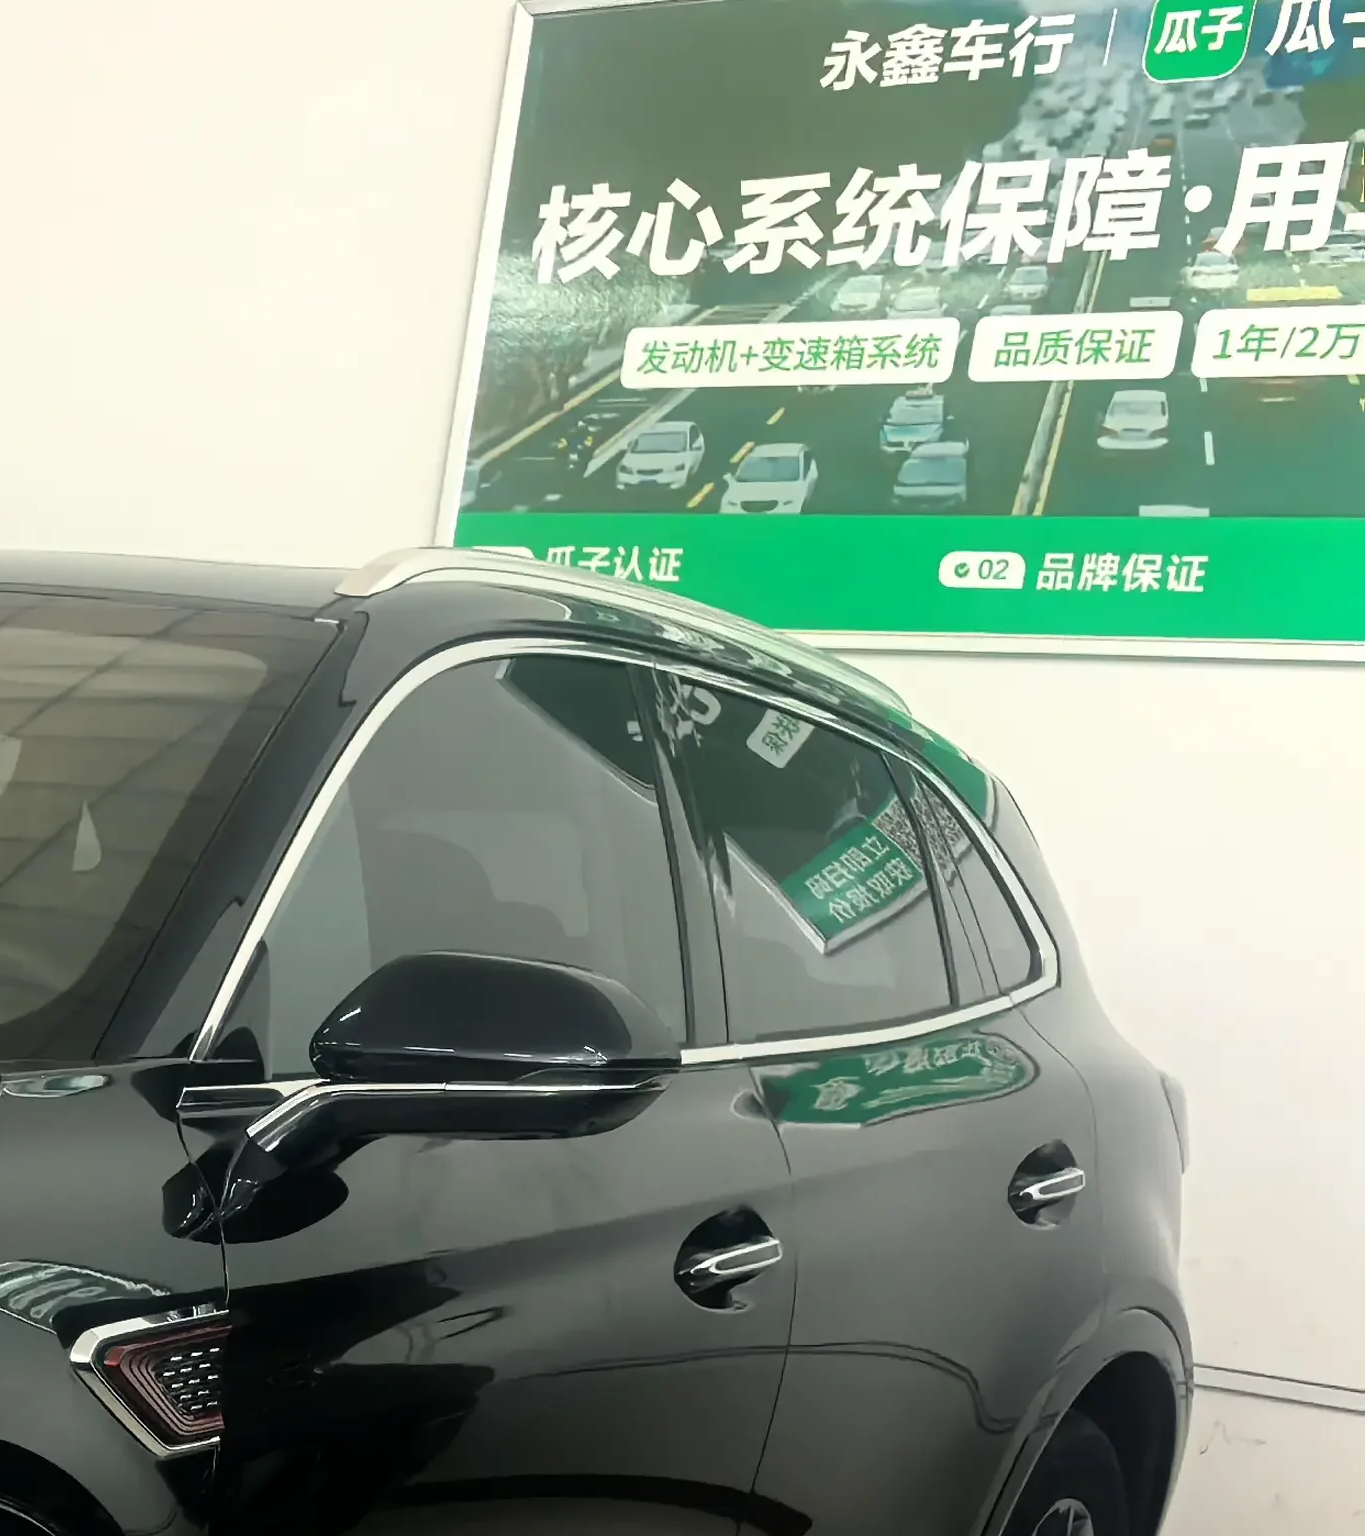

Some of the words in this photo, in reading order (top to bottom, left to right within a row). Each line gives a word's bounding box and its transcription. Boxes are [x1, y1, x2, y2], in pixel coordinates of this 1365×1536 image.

[819, 14, 1075, 91] 永鑫车行
[1154, 5, 1244, 56] 瓜子
[1265, 0, 1365, 55] 瓜
[531, 141, 1365, 284] 核心系统保障·用
[636, 332, 943, 375] 发动机+变速箱系统
[993, 328, 1157, 369] 品质保证
[976, 559, 1008, 582] 02
[1035, 553, 1209, 593] 品牌保证
